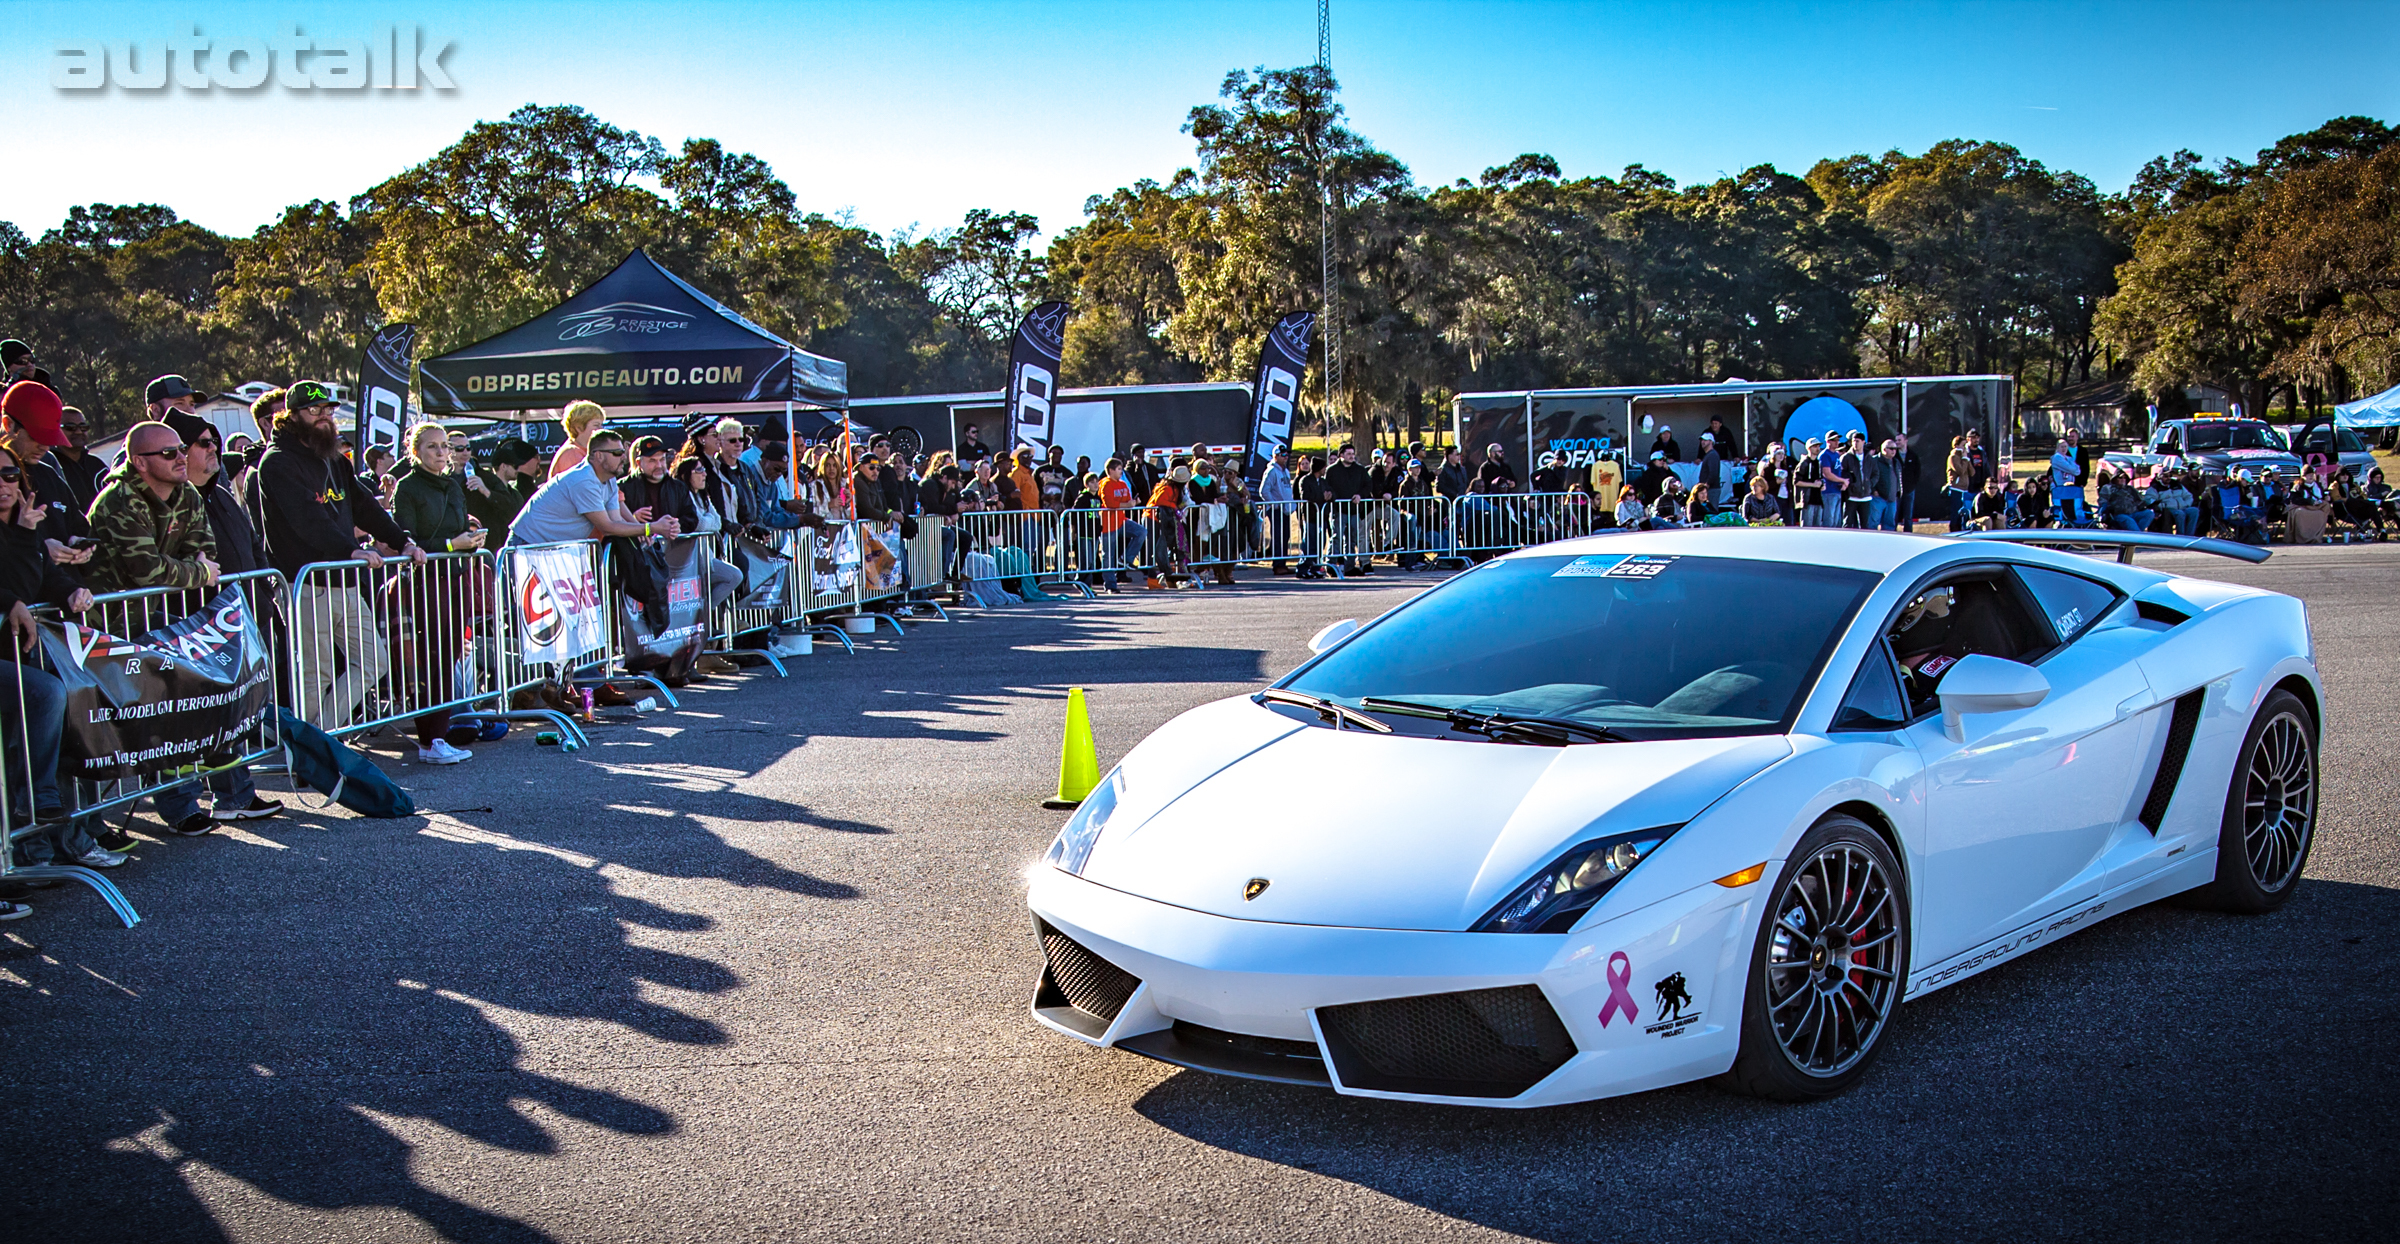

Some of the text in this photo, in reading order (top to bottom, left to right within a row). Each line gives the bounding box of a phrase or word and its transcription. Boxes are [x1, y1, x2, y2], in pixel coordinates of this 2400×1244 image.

[616, 325, 660, 334] AUTO
[619, 318, 689, 329] PRESTIGE
[467, 365, 743, 394] OBPRESTIGEAUTO.COM
[369, 386, 402, 462] CC
[1549, 437, 1611, 452] wanna
[115, 703, 156, 721] MODEL
[158, 699, 173, 717] GM
[84, 733, 215, 769] www.VengeanceRacing.net
[1905, 901, 2108, 986] UNDERGROUND RACING
[1645, 1015, 1700, 1035] WOUNDED WARRIOR
[1661, 1027, 1686, 1040] PROJECT
